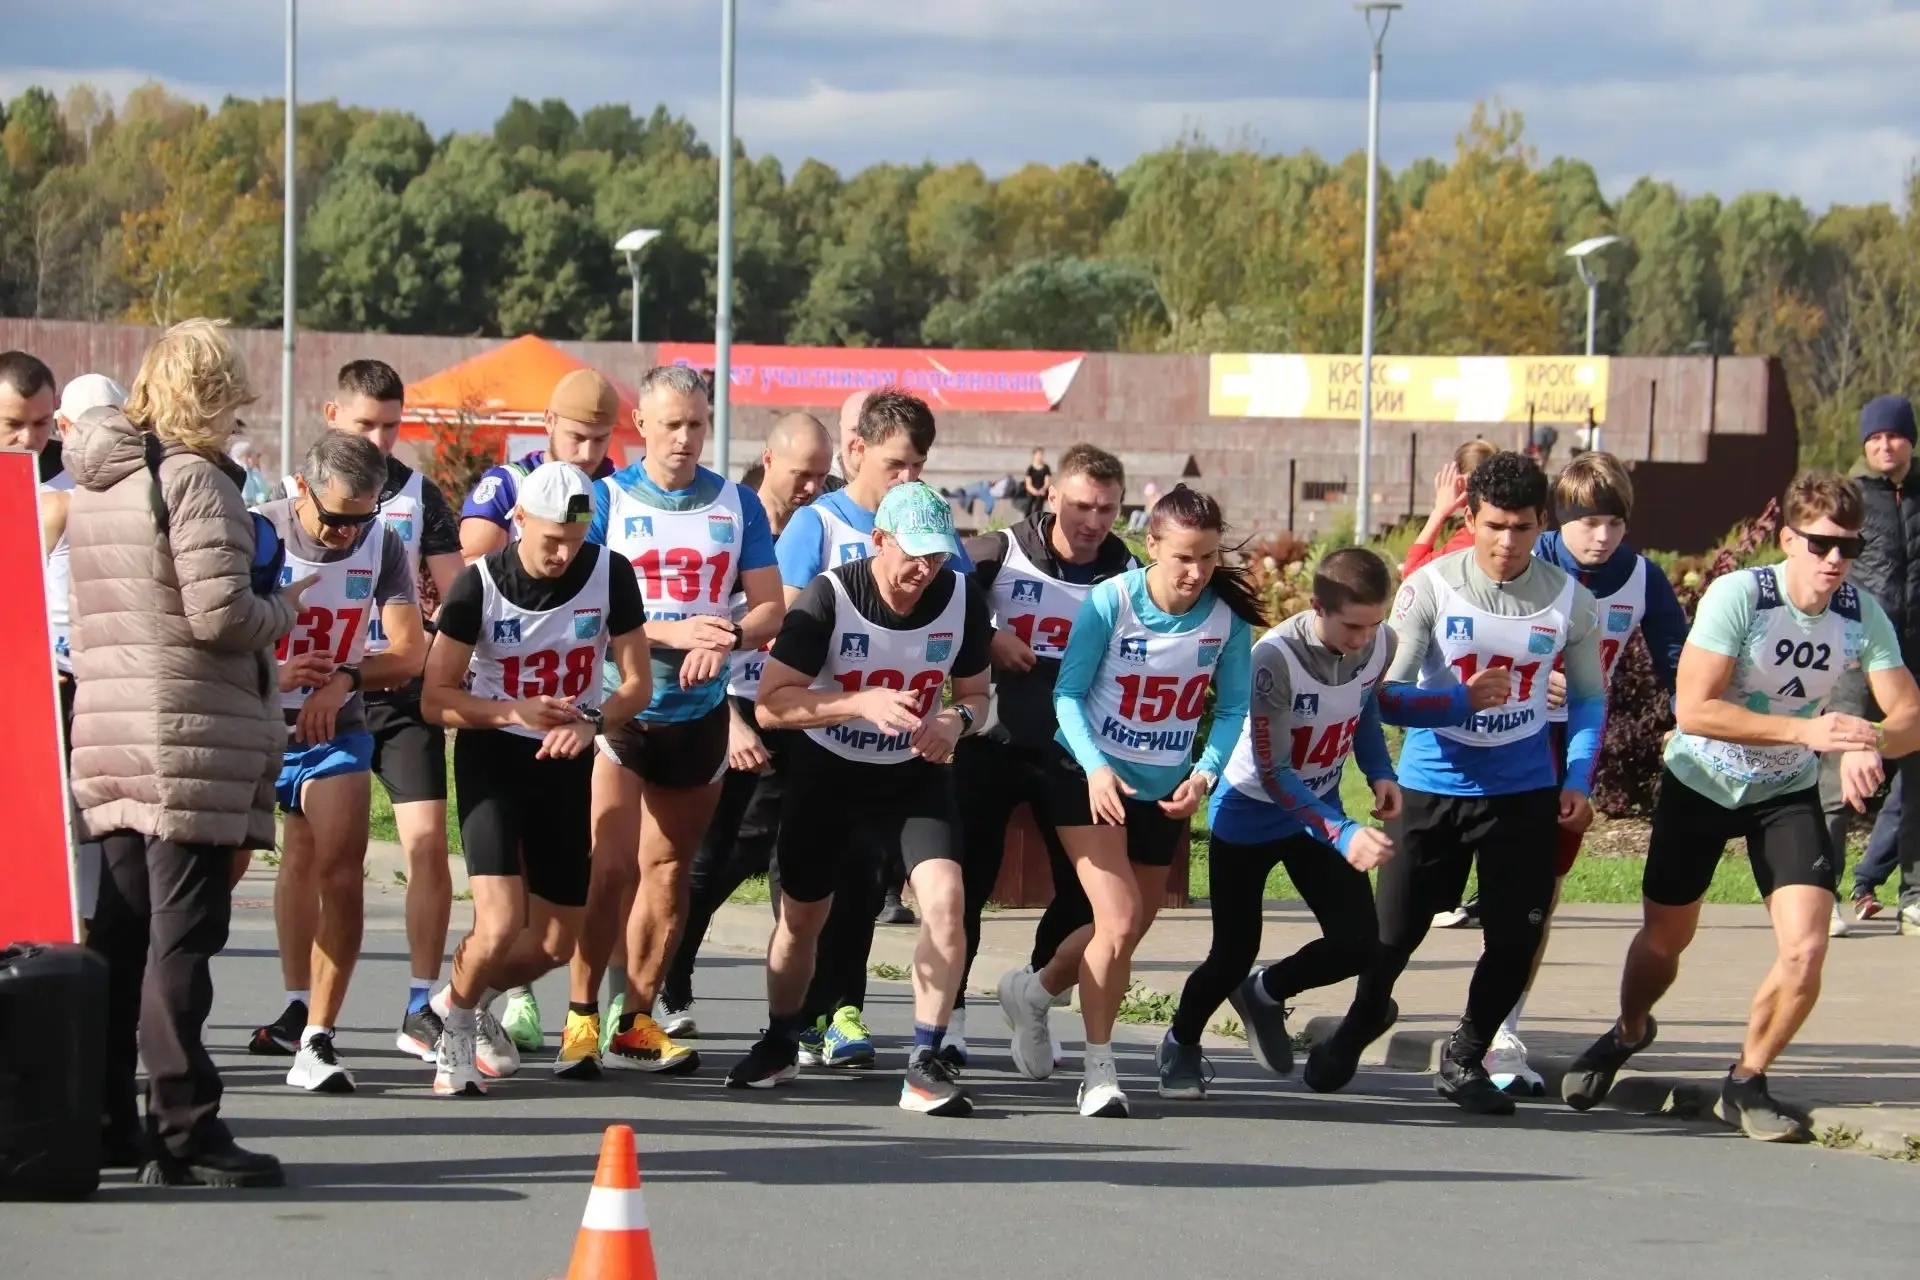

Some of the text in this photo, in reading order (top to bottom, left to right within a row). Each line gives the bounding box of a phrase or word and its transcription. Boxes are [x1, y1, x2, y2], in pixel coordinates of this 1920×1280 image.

[1525, 363, 1577, 385] КРОСС
[1524, 390, 1591, 415] НАЦИИ
[631, 547, 730, 603] 131
[1007, 613, 1073, 648] 13
[1774, 638, 1831, 671] 902
[495, 645, 597, 700] 138
[1115, 674, 1210, 722] 150
[825, 724, 911, 752] КИРИШ
